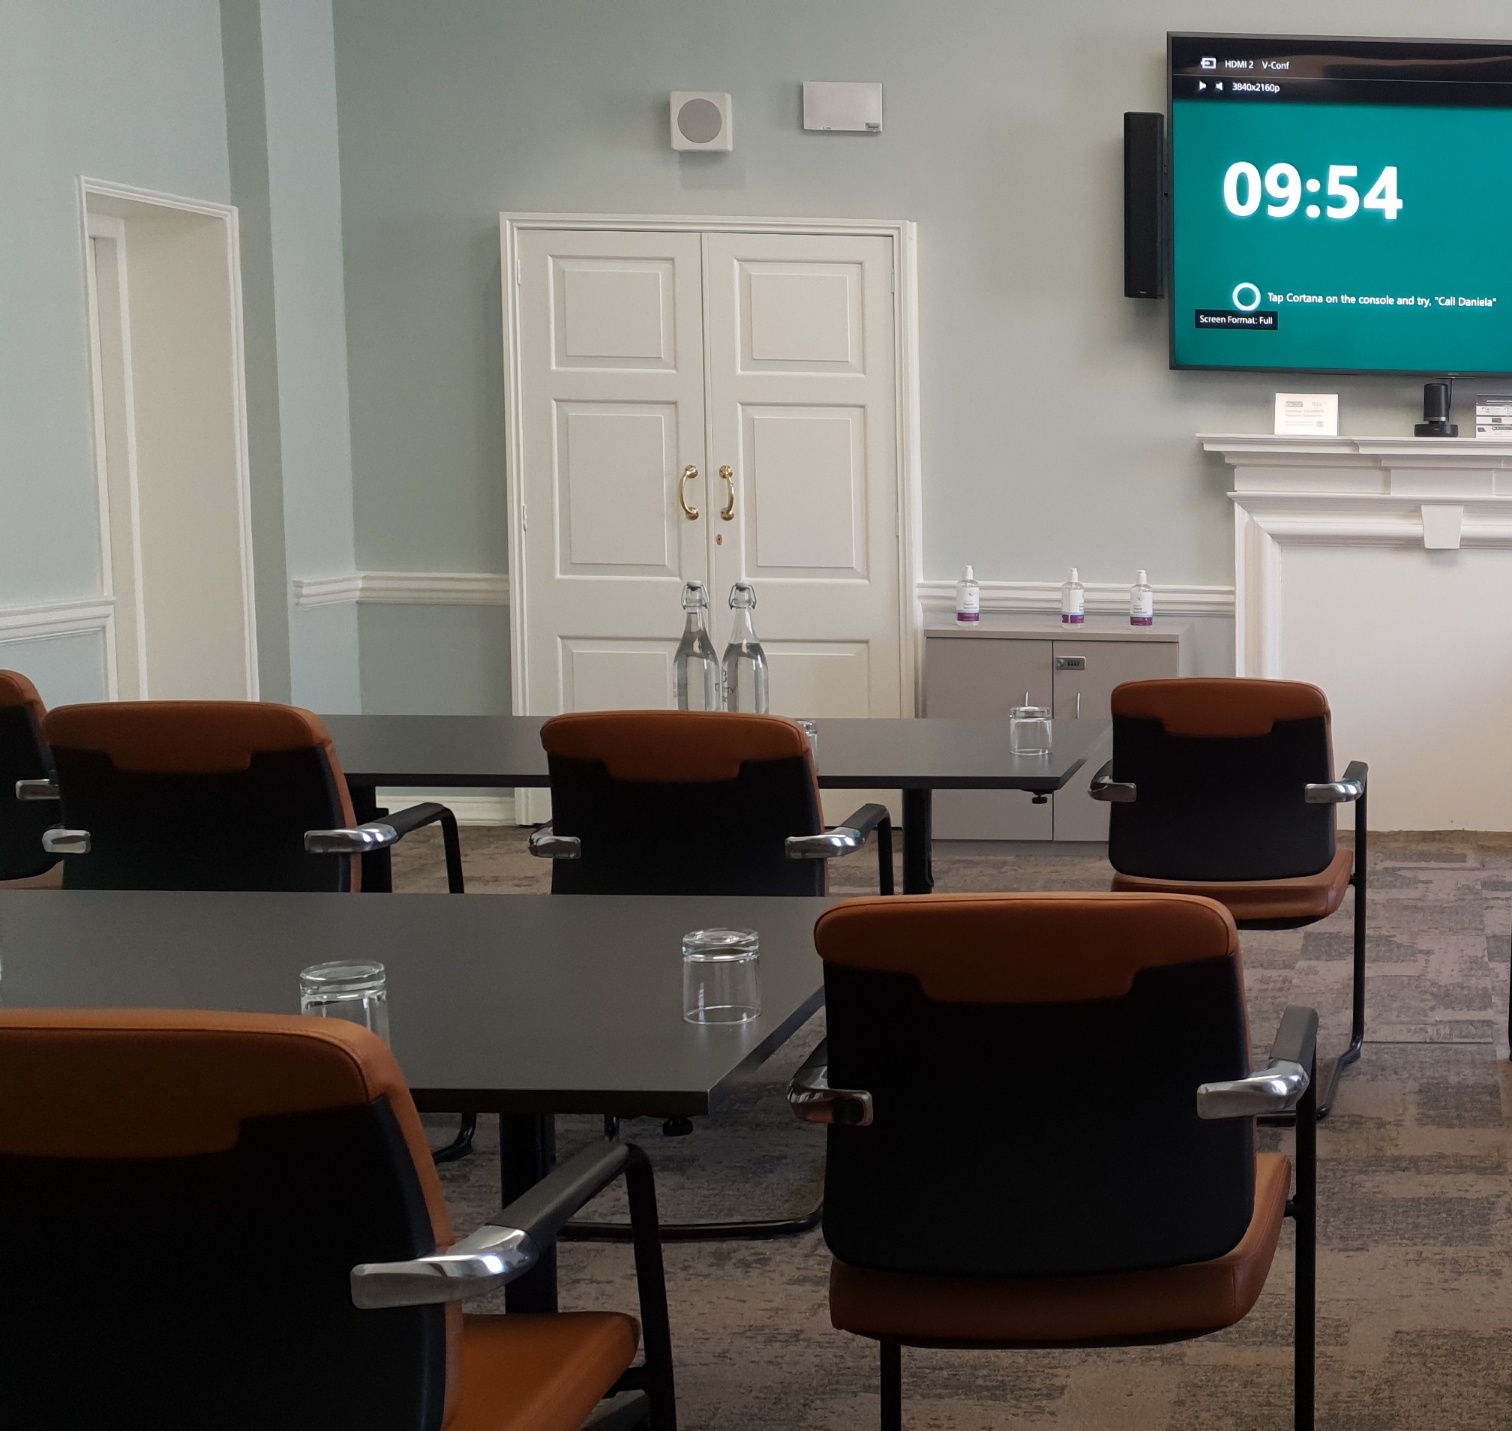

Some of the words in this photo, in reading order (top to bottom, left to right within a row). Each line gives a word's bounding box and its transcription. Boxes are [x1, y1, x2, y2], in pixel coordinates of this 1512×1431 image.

[1225, 60, 1247, 69] HDMI
[1248, 60, 1254, 69] 2
[1261, 61, 1290, 70] V-Conf
[1232, 82, 1280, 94] 3840x2160p
[1223, 161, 1404, 220] 09:54
[1268, 292, 1284, 304] Tap
[1286, 293, 1323, 303] Cortana
[1326, 295, 1338, 304] on
[1341, 294, 1356, 304] the
[1358, 295, 1394, 305] console
[1397, 296, 1415, 305] and
[1417, 297, 1432, 308] try,
[1435, 297, 1456, 306] "Call
[1458, 297, 1497, 307] Daniela"
[1200, 315, 1226, 324] Screen
[1228, 316, 1258, 325] Format:
[1259, 316, 1273, 325] Full
